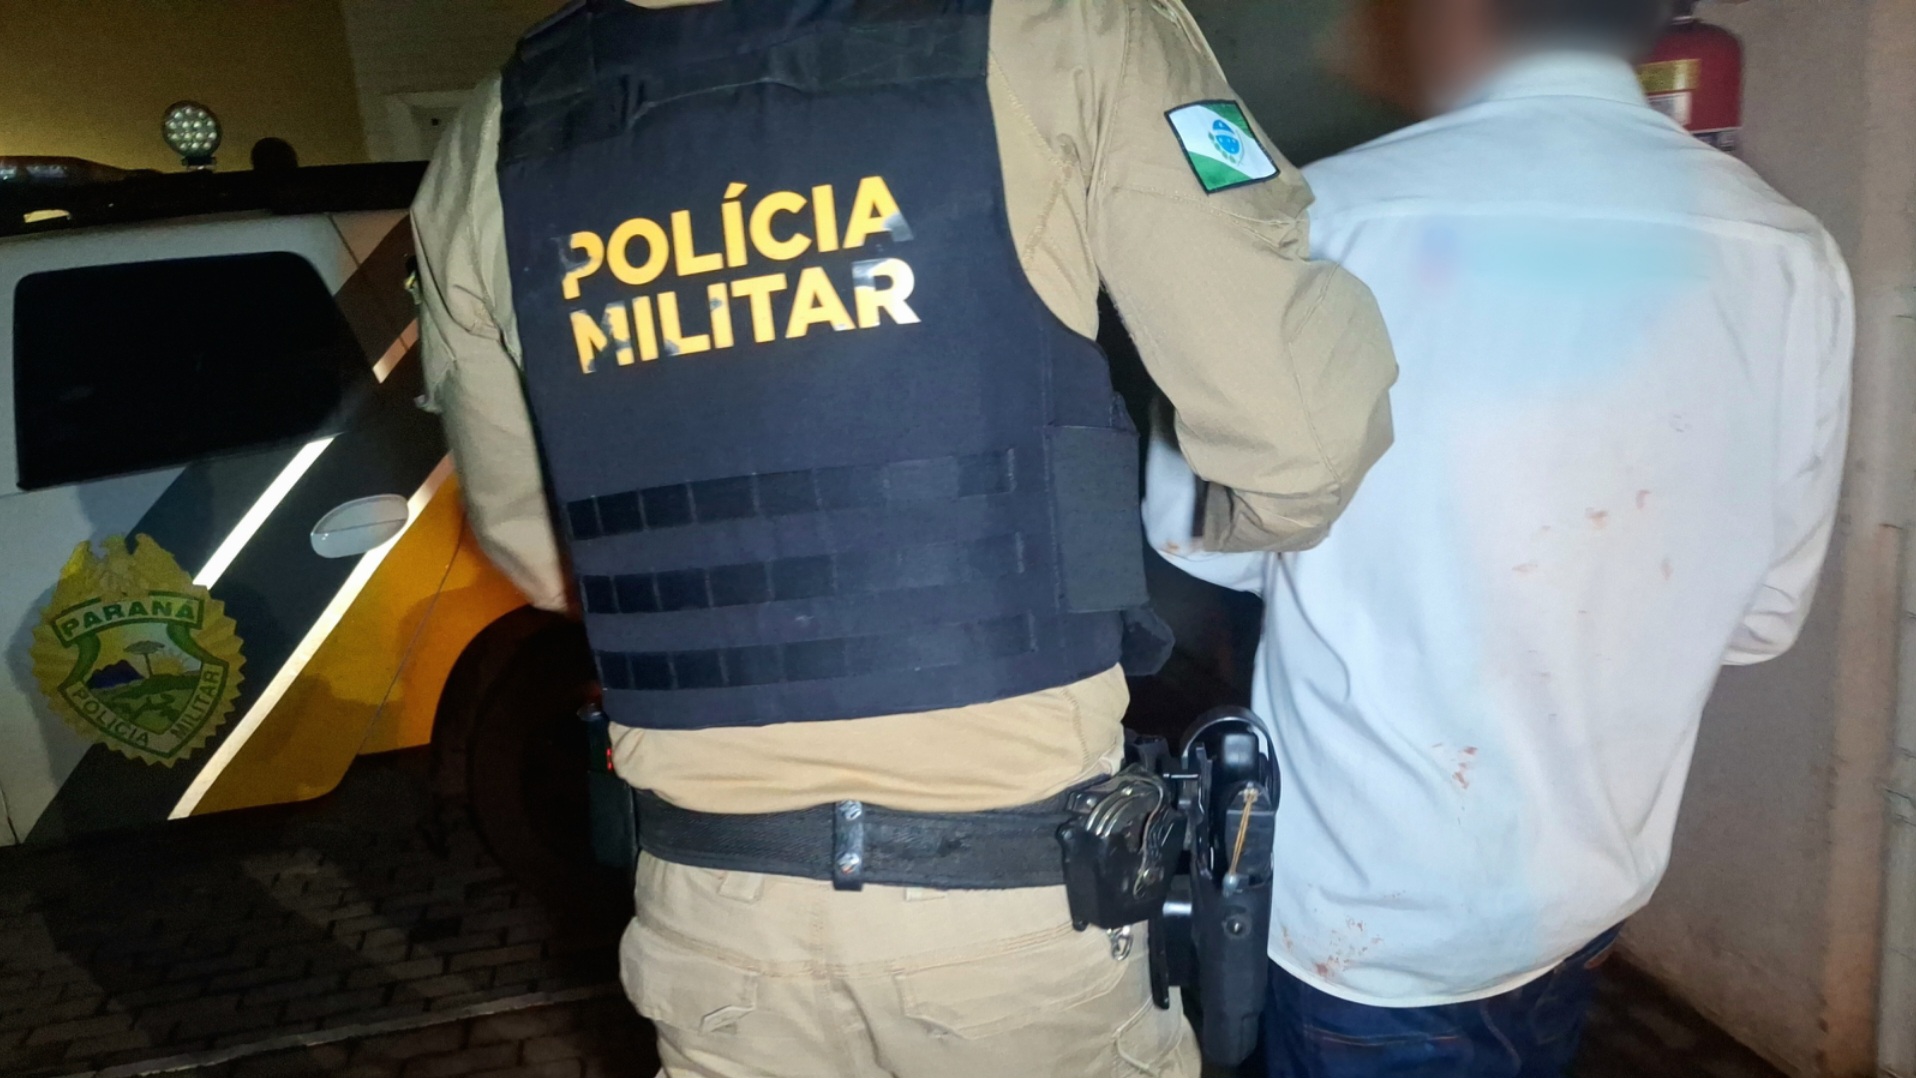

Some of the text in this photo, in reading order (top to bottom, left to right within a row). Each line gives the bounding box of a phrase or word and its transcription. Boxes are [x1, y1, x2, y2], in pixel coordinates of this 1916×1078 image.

[552, 175, 914, 299] POLÍCIA
[570, 257, 922, 375] MILITAR
[170, 670, 220, 740] MILITAR
